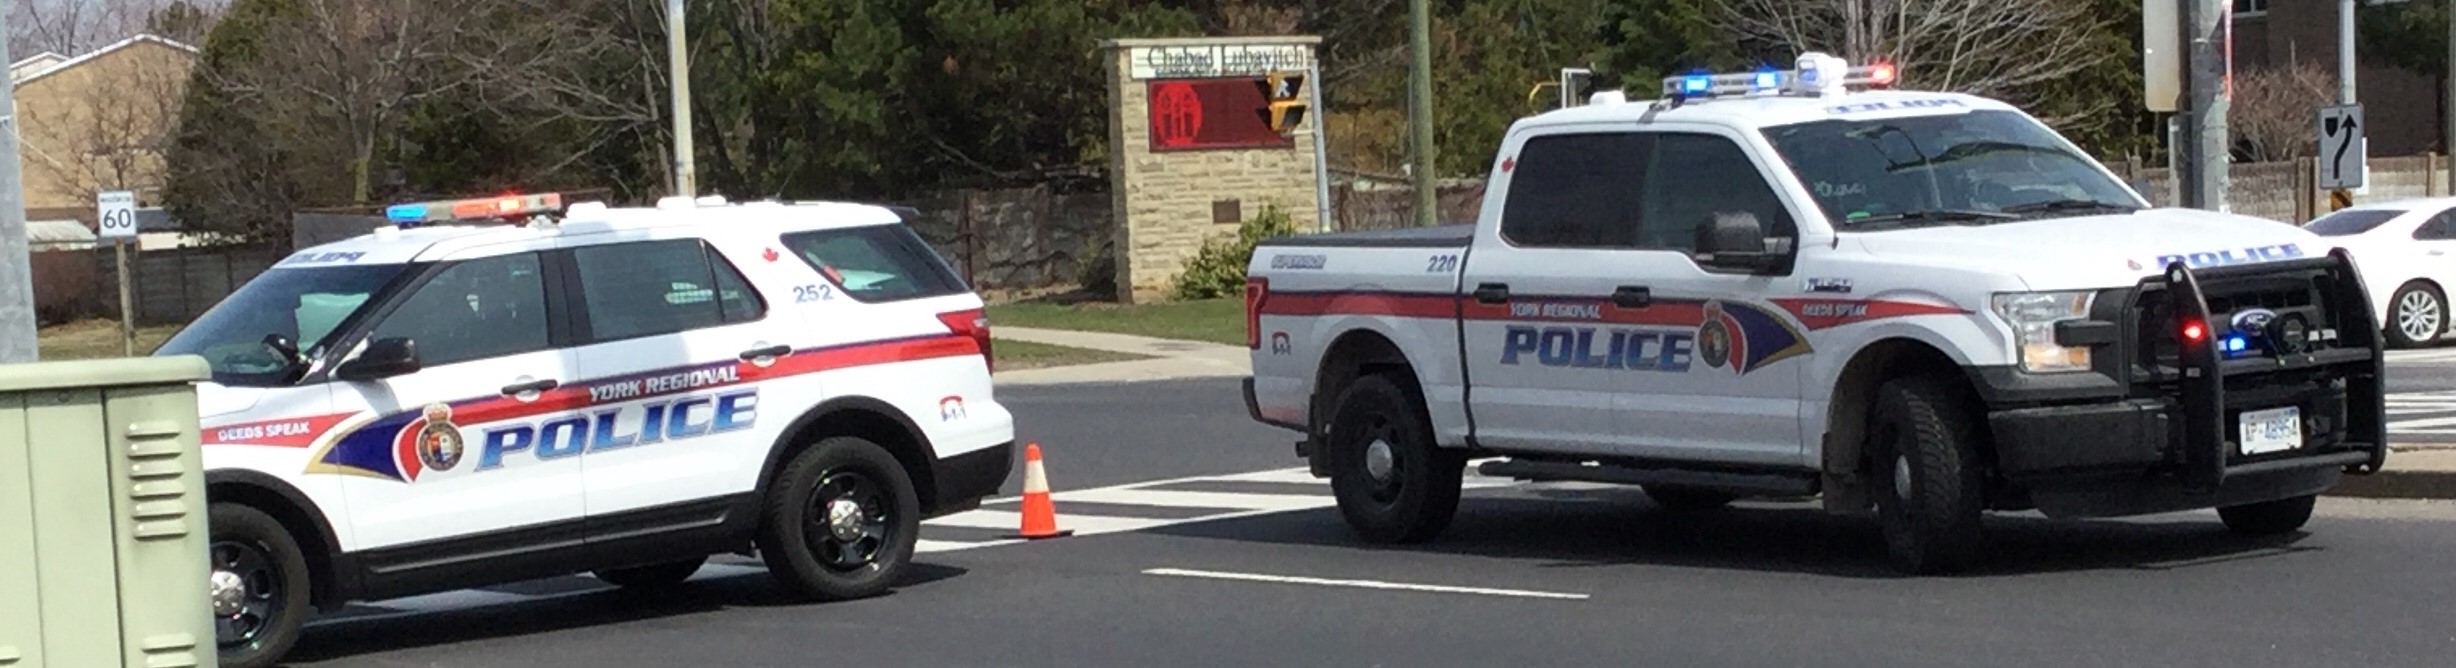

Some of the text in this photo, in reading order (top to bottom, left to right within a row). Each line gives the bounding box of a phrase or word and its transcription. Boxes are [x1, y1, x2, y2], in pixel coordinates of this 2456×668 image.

[1148, 44, 1305, 67] Chabad Lubavitch
[103, 208, 131, 229] 60
[1427, 254, 1458, 272] 220
[2156, 243, 2304, 270] POLICE
[792, 284, 834, 304] 252
[1510, 302, 1601, 319] YORK REGIONAL
[1500, 324, 1694, 373] POLICE
[589, 365, 740, 402] YORK REGIONAL
[218, 421, 310, 442] DEEDS SPEAK
[474, 387, 759, 472] POLICE
